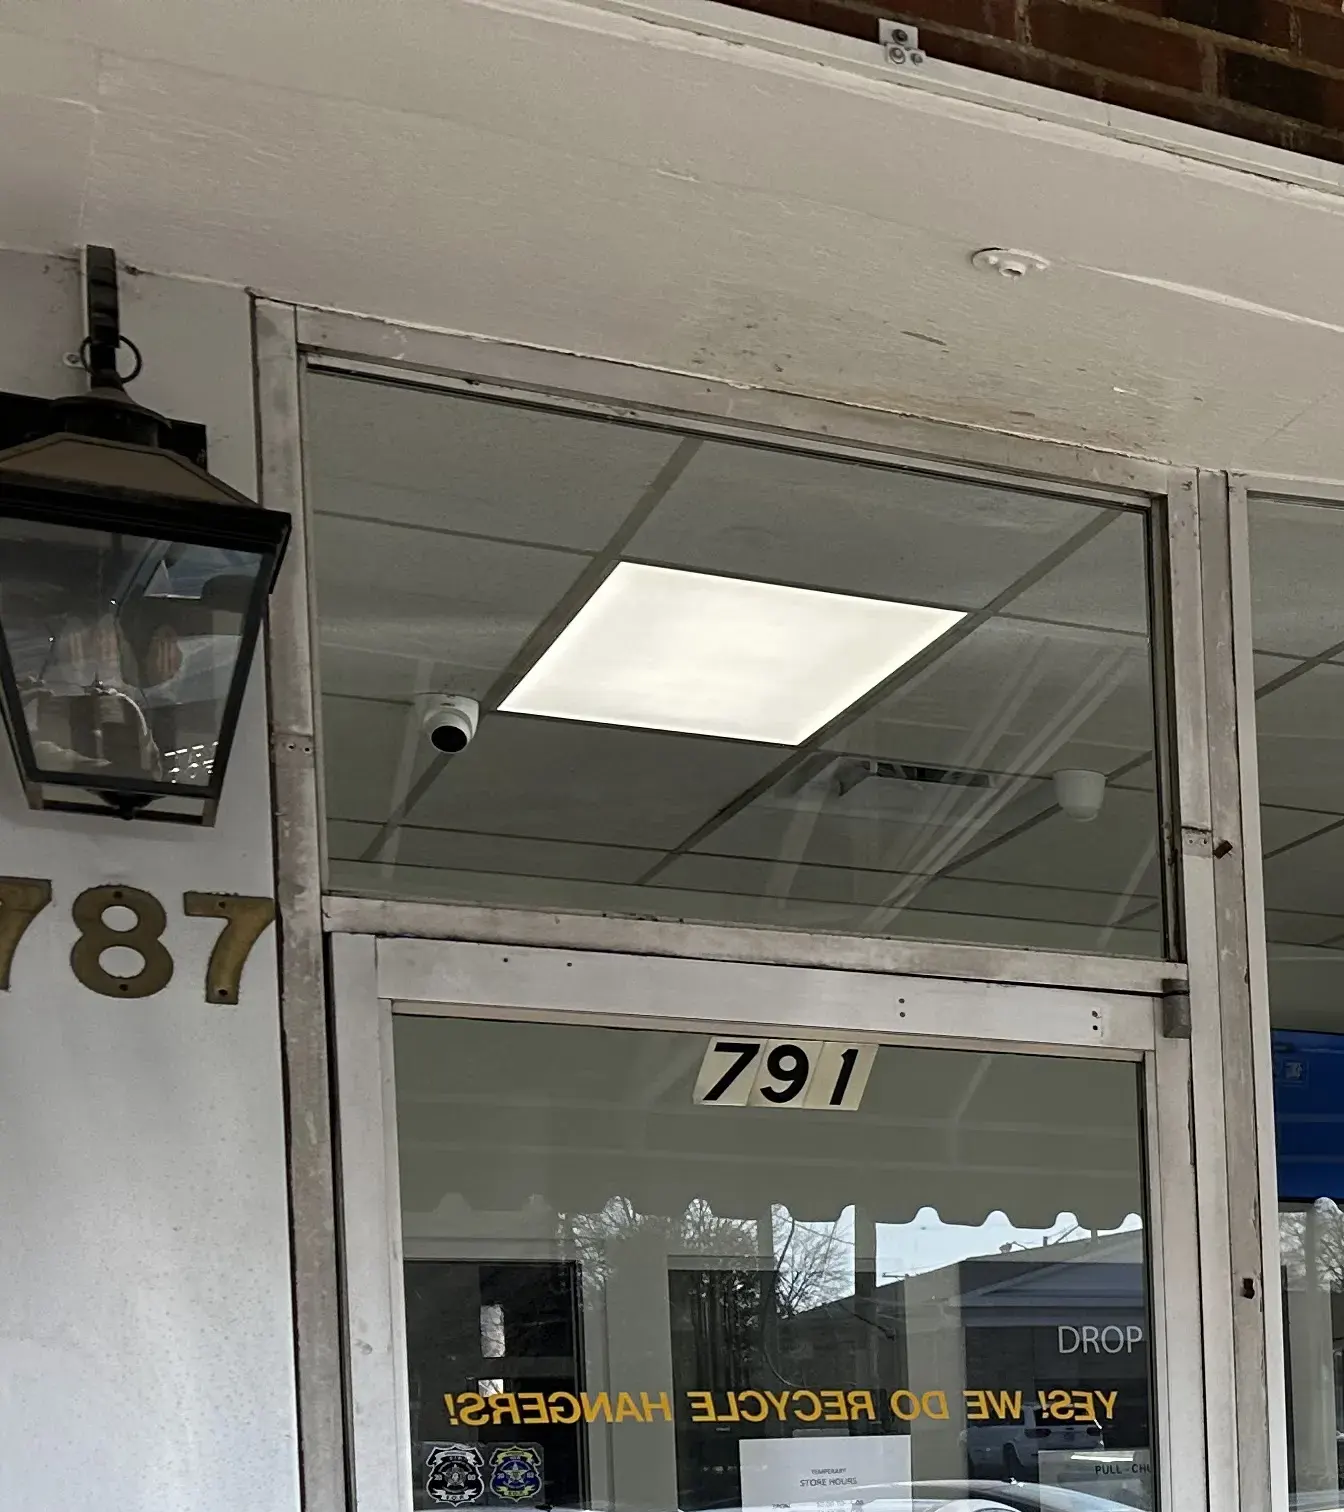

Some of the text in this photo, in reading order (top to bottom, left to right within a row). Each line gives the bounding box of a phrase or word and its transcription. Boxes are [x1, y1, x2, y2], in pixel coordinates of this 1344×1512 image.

[0, 876, 275, 1005] 787
[703, 1041, 859, 1105] 791
[1058, 1325, 1144, 1355] DROP
[800, 1477, 857, 1487] STORE HOURS
[1095, 1464, 1122, 1475] PULL
